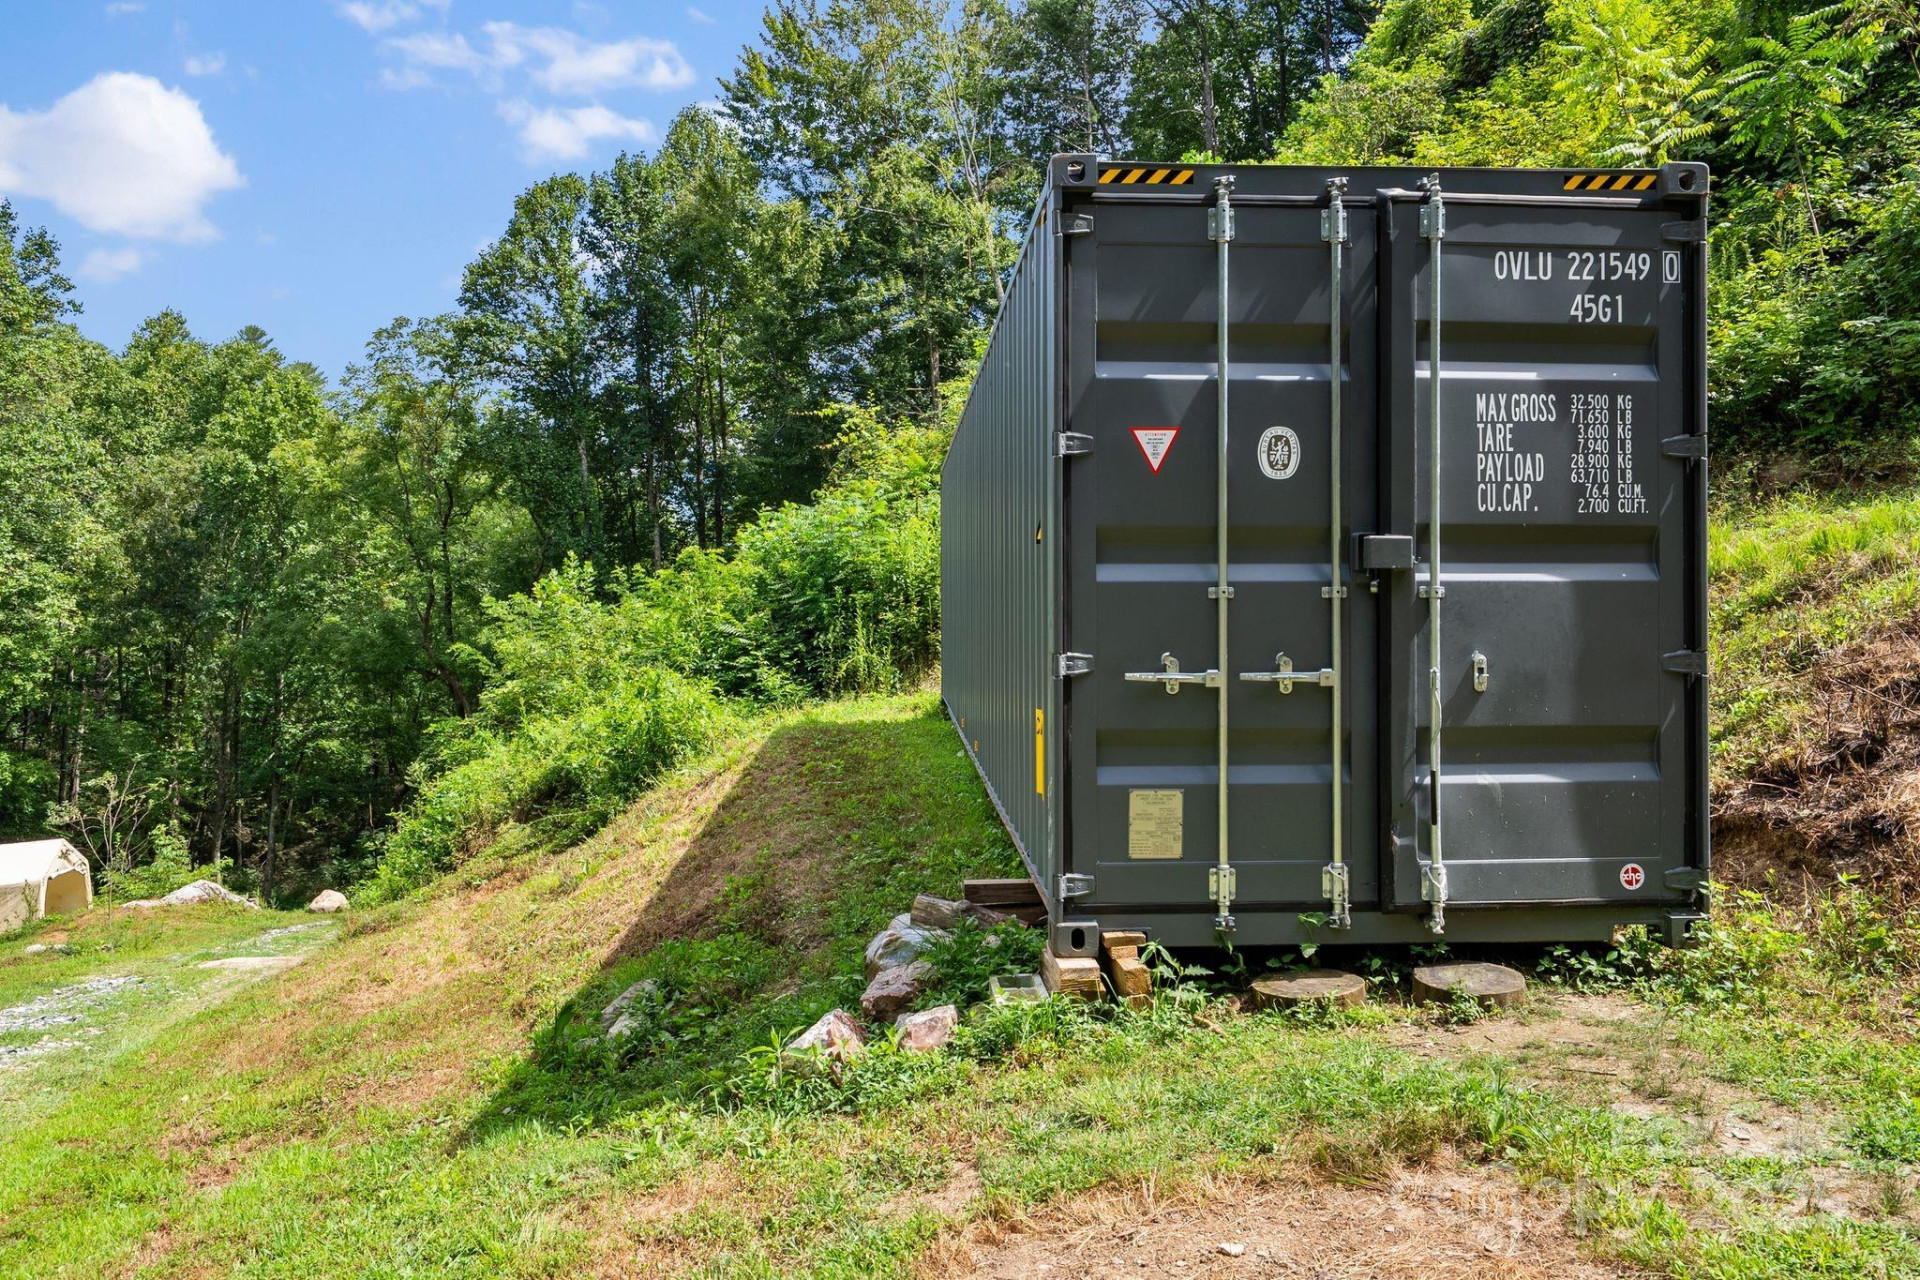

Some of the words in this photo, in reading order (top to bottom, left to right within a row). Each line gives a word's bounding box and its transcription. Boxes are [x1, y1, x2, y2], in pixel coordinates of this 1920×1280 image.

[1494, 251, 1552, 280] OVLU
[1568, 252, 1650, 281] 221549
[1665, 253, 1678, 281] 0
[1570, 294, 1622, 323] 45G1
[1476, 393, 1507, 422] MAX
[1511, 394, 1556, 422] GROSS
[1571, 394, 1609, 409] 32.500
[1617, 395, 1632, 409] KG
[1571, 410, 1609, 424] 71.650
[1617, 410, 1632, 424] LB
[1477, 423, 1513, 452] TARE
[1578, 424, 1609, 439] 3.600
[1617, 425, 1632, 439] KG
[1578, 439, 1609, 453] 7.940
[1617, 440, 1632, 453] LB
[1477, 454, 1544, 482] PAYLOAD
[1571, 454, 1609, 469] 28.900
[1617, 454, 1632, 469] KG
[1571, 469, 1609, 483] 63.710
[1617, 469, 1632, 483] LB
[1585, 484, 1609, 498] 76.4
[1618, 484, 1643, 498] CU.M.
[1578, 499, 1609, 514] 2.700
[1618, 500, 1649, 514] CU.FT.
